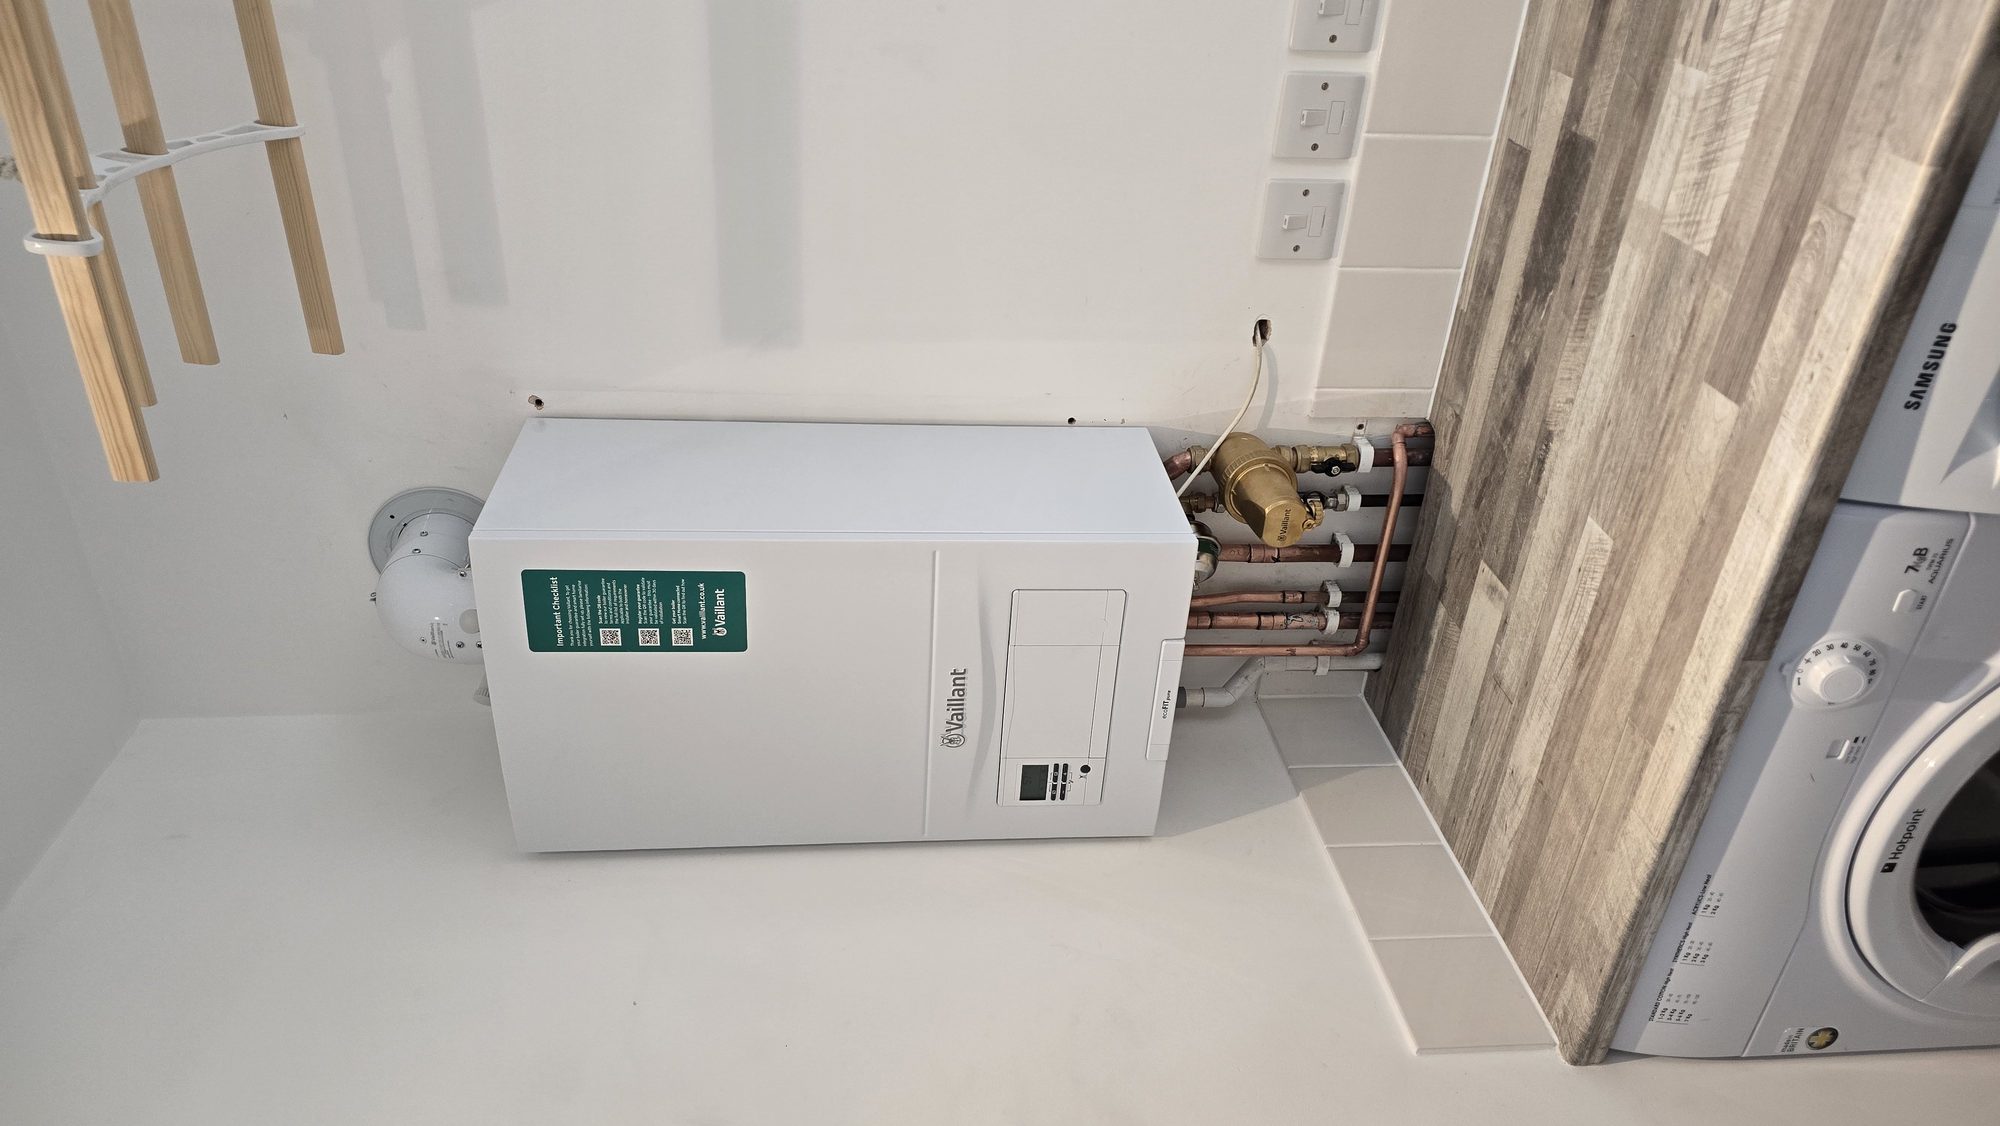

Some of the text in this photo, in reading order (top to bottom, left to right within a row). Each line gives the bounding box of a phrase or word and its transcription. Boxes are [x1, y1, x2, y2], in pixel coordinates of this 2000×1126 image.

[1903, 322, 1957, 411] SAMSUNG
[1279, 509, 1291, 535] Vaillant
[1928, 538, 1954, 584] AQUARIUS
[550, 577, 564, 646] Important Checklist
[698, 583, 707, 639] www.vaillant.co.uk
[714, 588, 725, 626] Vaillant
[1916, 595, 1928, 610] START
[1812, 648, 1821, 657] 20
[1826, 643, 1834, 651] 30
[945, 668, 966, 733] Vaillant
[1887, 808, 1926, 860] Hotpoint
[1786, 1028, 1805, 1052] BRITAIN
